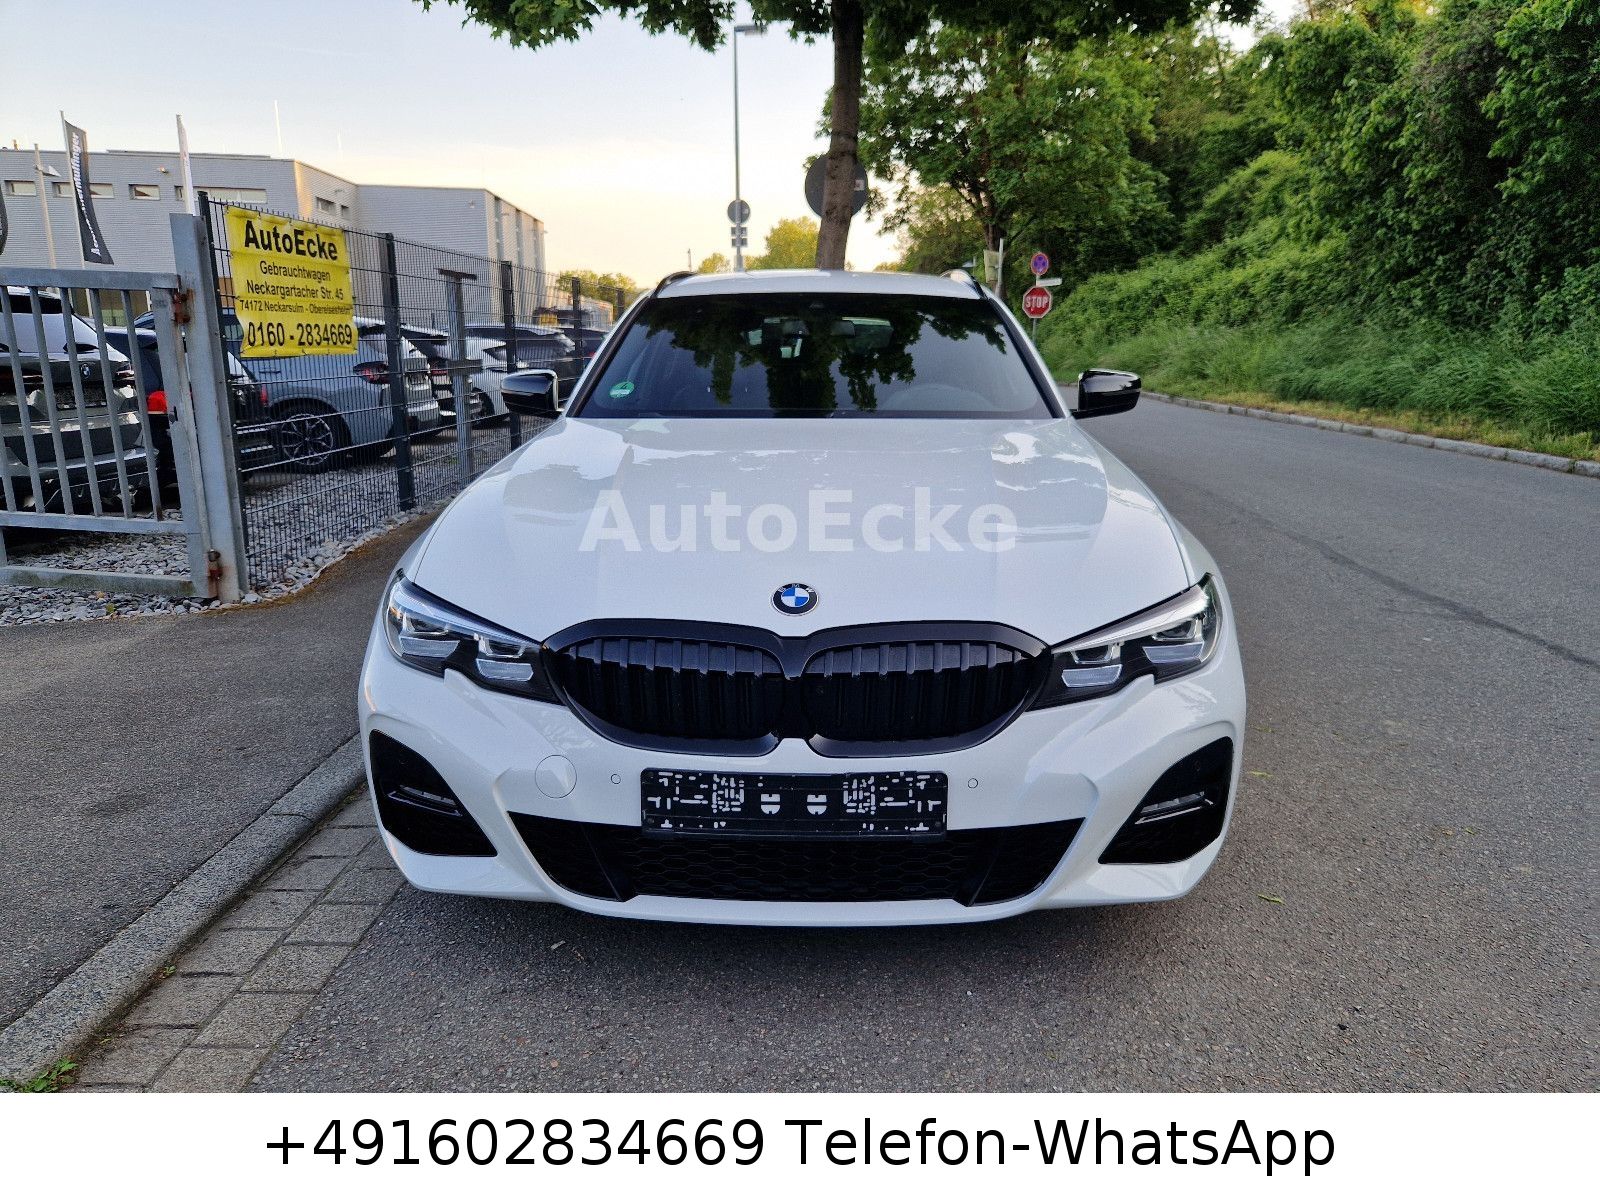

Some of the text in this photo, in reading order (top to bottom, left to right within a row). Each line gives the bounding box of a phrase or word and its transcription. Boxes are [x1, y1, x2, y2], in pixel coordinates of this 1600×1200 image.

[244, 220, 338, 260] AutoEcke
[260, 260, 331, 283] Gebrauchtwagen
[246, 280, 344, 300] Neckargartacher Str. 45
[240, 299, 263, 312] 74172
[264, 300, 304, 313] Neckarsulm
[1025, 296, 1048, 309] STOP
[247, 322, 285, 346] 0160
[296, 322, 352, 346] 2834669
